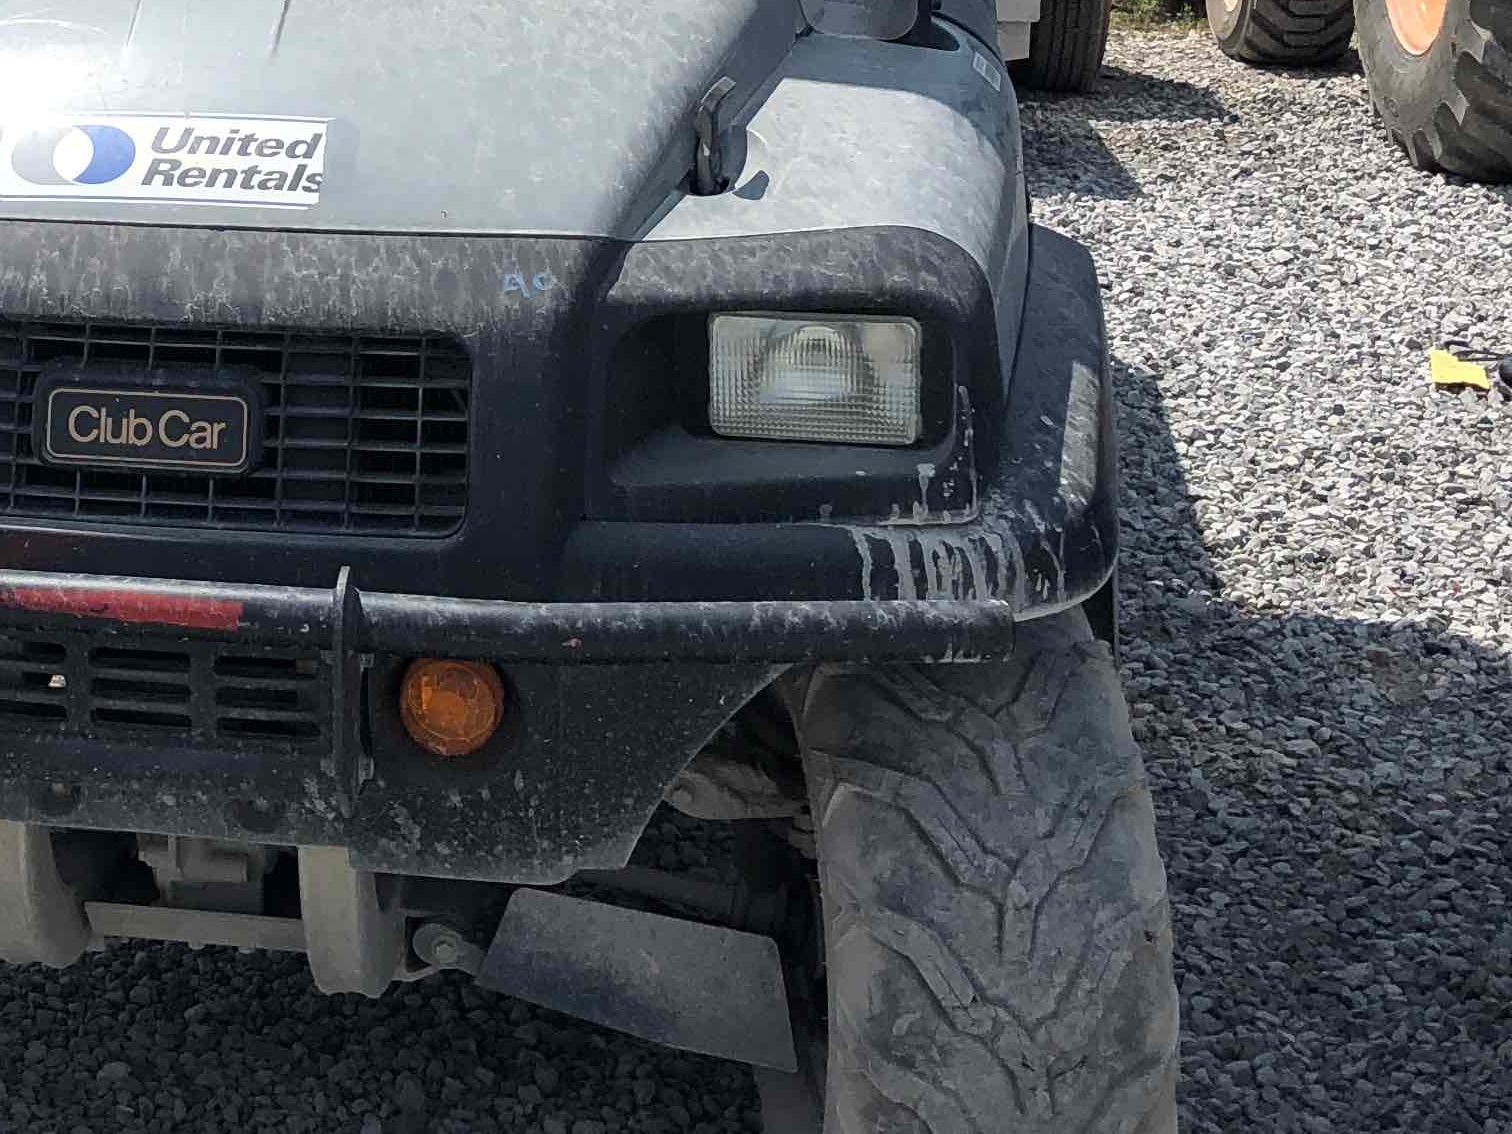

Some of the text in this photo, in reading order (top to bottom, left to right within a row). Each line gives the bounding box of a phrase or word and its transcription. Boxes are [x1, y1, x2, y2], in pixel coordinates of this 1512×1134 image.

[151, 126, 324, 159] United
[141, 158, 324, 193] Rentals
[68, 405, 227, 450] Club Car
